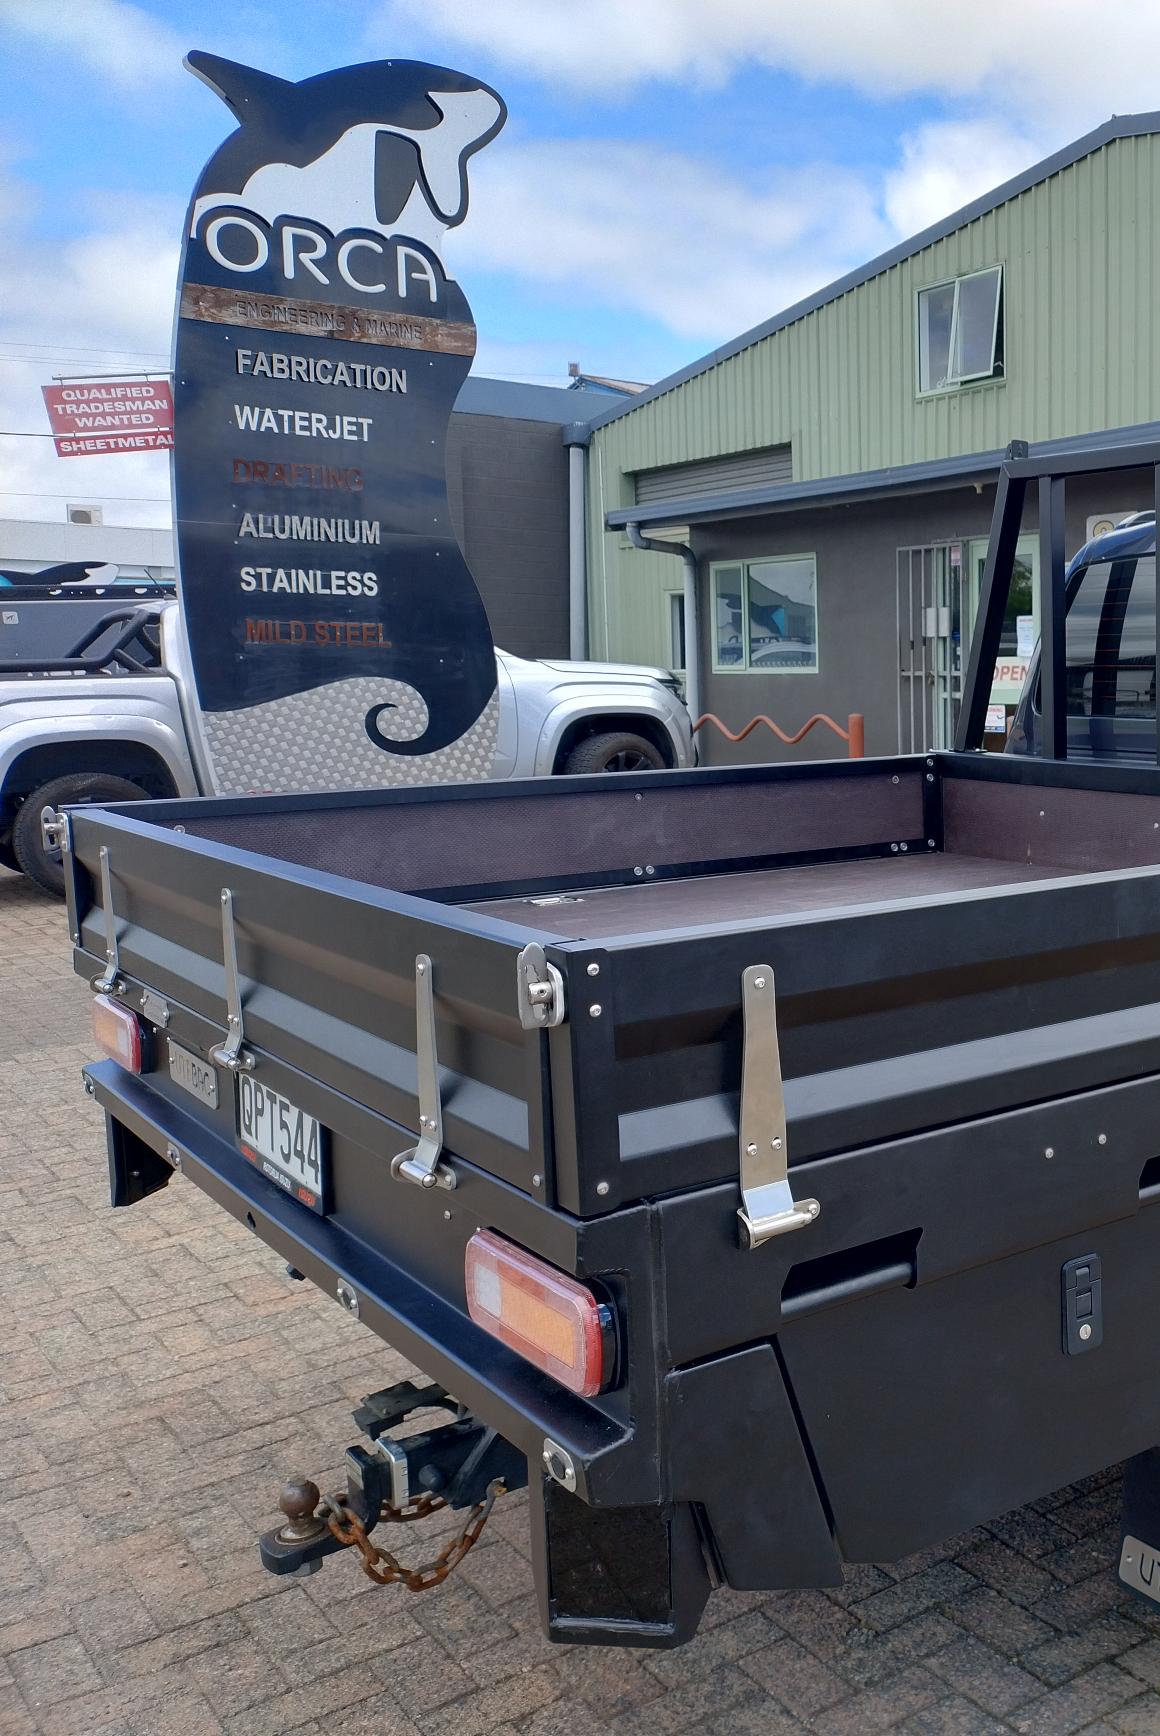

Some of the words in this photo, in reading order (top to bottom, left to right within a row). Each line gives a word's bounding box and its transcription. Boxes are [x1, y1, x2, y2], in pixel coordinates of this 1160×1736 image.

[206, 216, 438, 303] ORCA
[235, 300, 346, 331] ENGINEERING
[365, 317, 423, 341] MARINE
[236, 348, 408, 394] FABRICATION
[53, 399, 169, 415] TRADESMAN
[61, 386, 155, 401] QUALIFIED
[75, 413, 155, 428] WANTED
[233, 404, 373, 442] WATERJET
[60, 434, 174, 452] SHEETMETAL
[232, 458, 364, 492] DRAFTING
[238, 512, 381, 545] ALUMINIUM
[240, 566, 379, 597] STAINLESS
[244, 617, 306, 645] MILD
[314, 619, 393, 649] STEEL
[241, 1075, 320, 1185] QPT544
